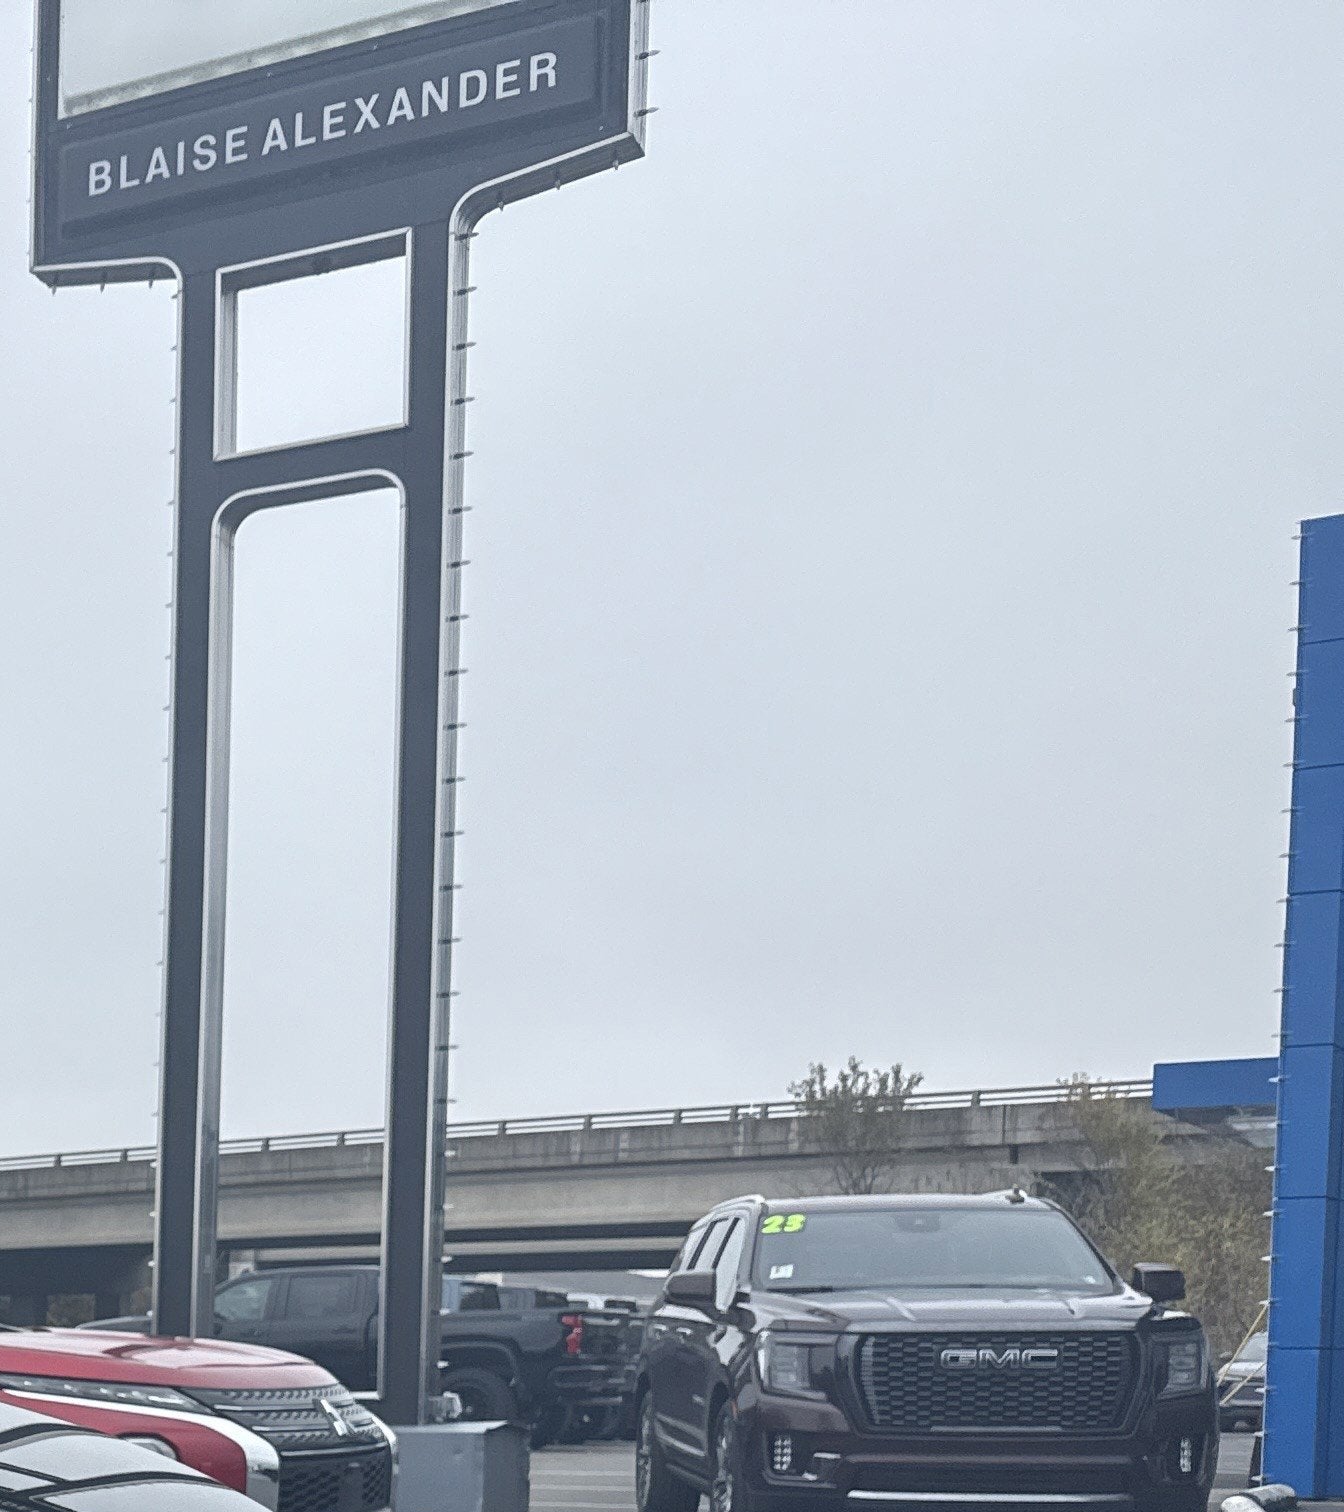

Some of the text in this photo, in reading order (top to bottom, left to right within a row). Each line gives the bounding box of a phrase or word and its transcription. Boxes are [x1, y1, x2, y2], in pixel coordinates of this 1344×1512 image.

[86, 51, 558, 197] BLAISE ALEXANDER
[940, 1348, 1059, 1370] GMC
